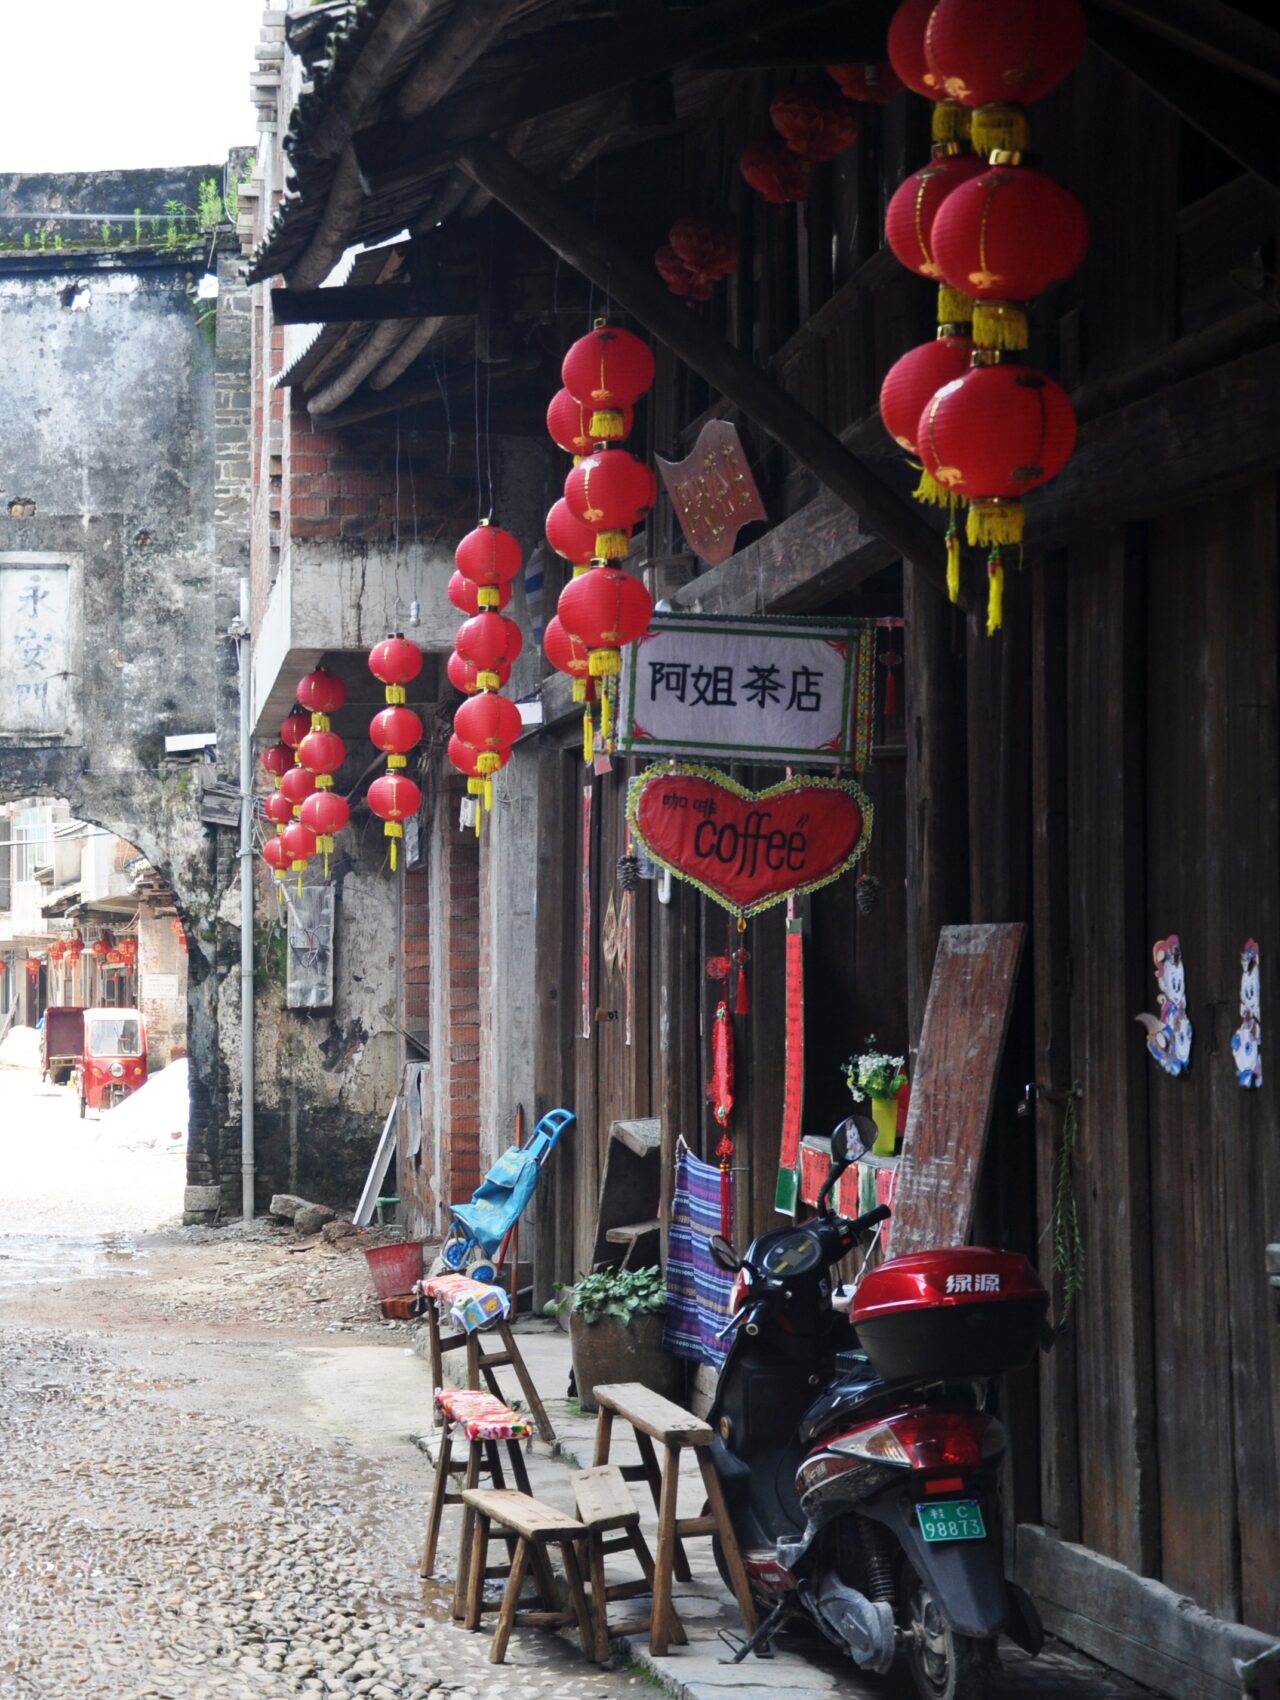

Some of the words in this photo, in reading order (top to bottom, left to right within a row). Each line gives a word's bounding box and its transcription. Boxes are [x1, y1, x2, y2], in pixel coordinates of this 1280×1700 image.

[648, 661, 824, 712] 阿姐茶店
[662, 792, 718, 818] 咖啡
[694, 811, 807, 878] coffee
[945, 1274, 1000, 1294] 绿源
[926, 1520, 980, 1538] 98873
